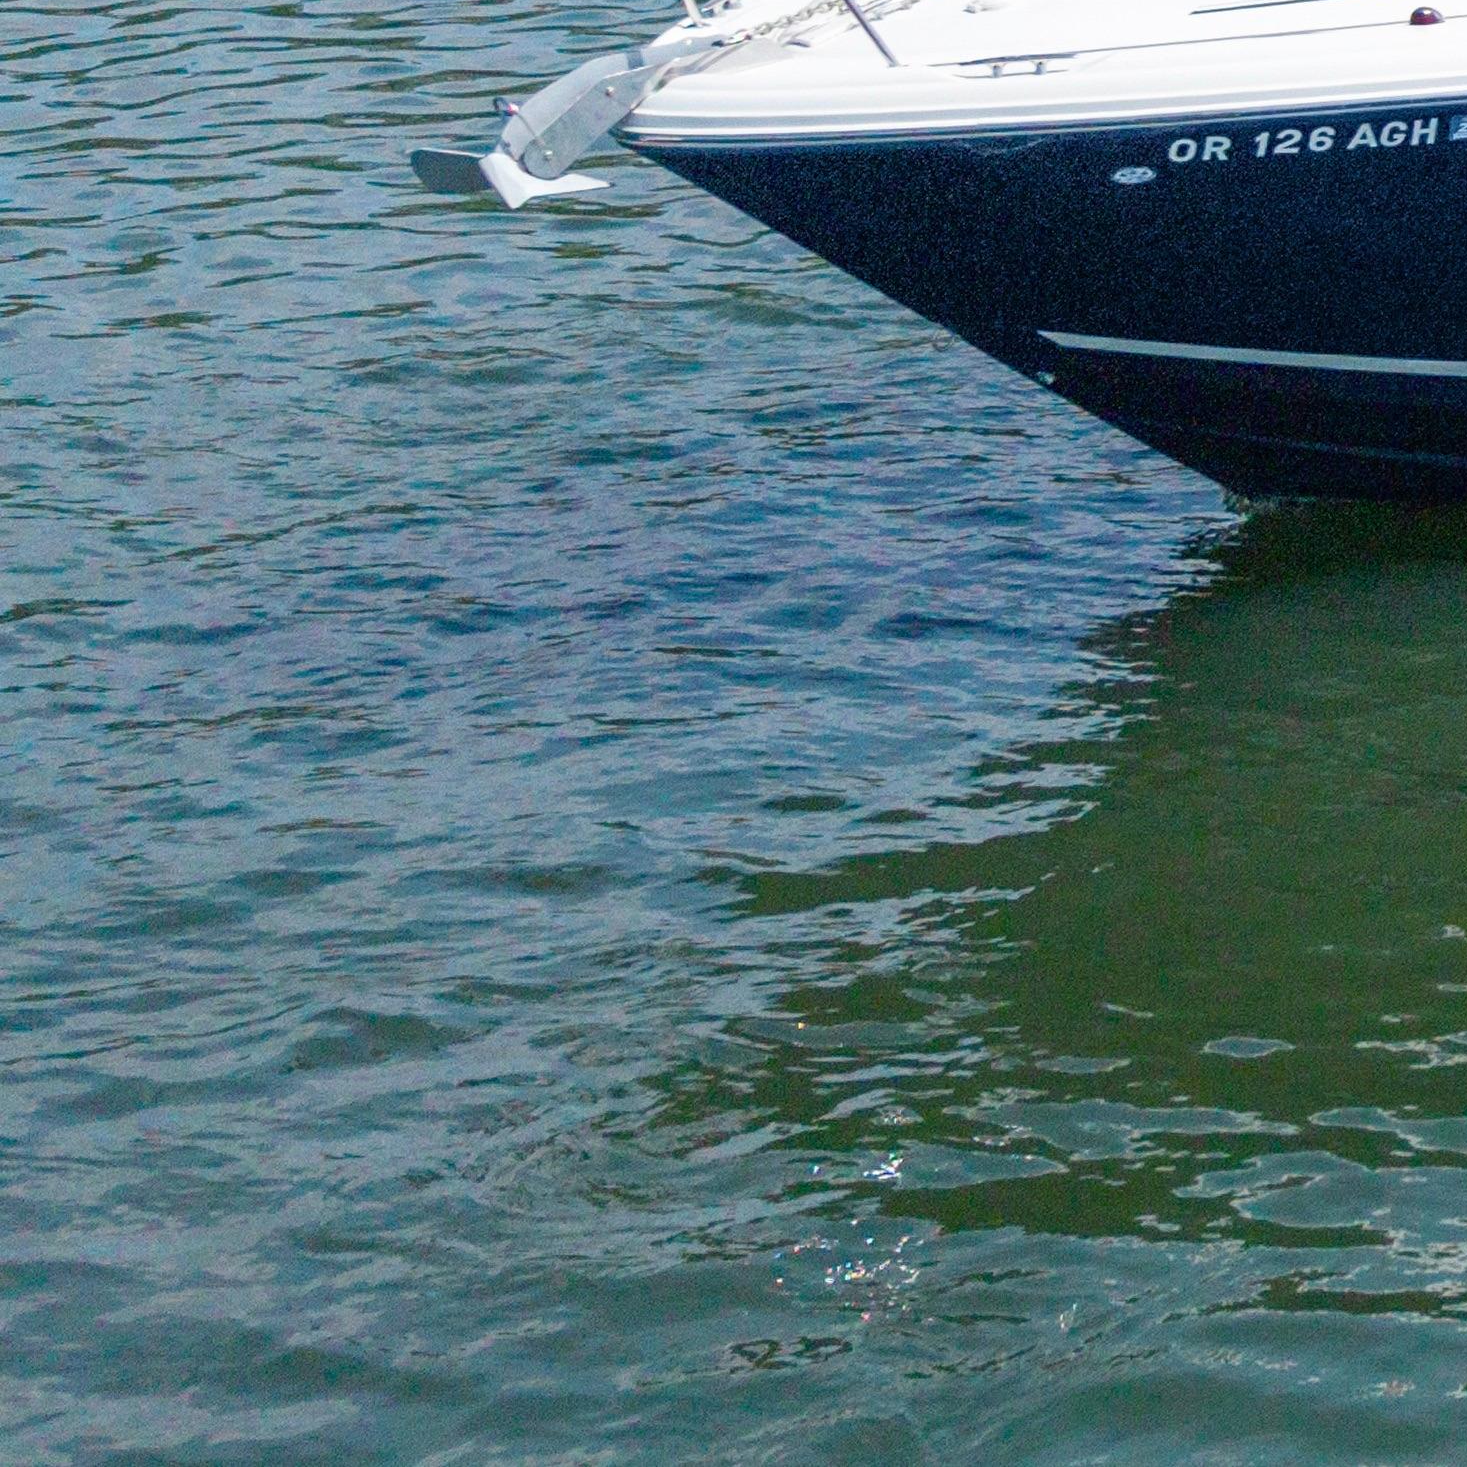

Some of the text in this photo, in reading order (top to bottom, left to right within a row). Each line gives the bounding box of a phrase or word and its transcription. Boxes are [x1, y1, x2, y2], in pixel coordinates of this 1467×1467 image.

[1167, 117, 1439, 163] OR 126 AGH
